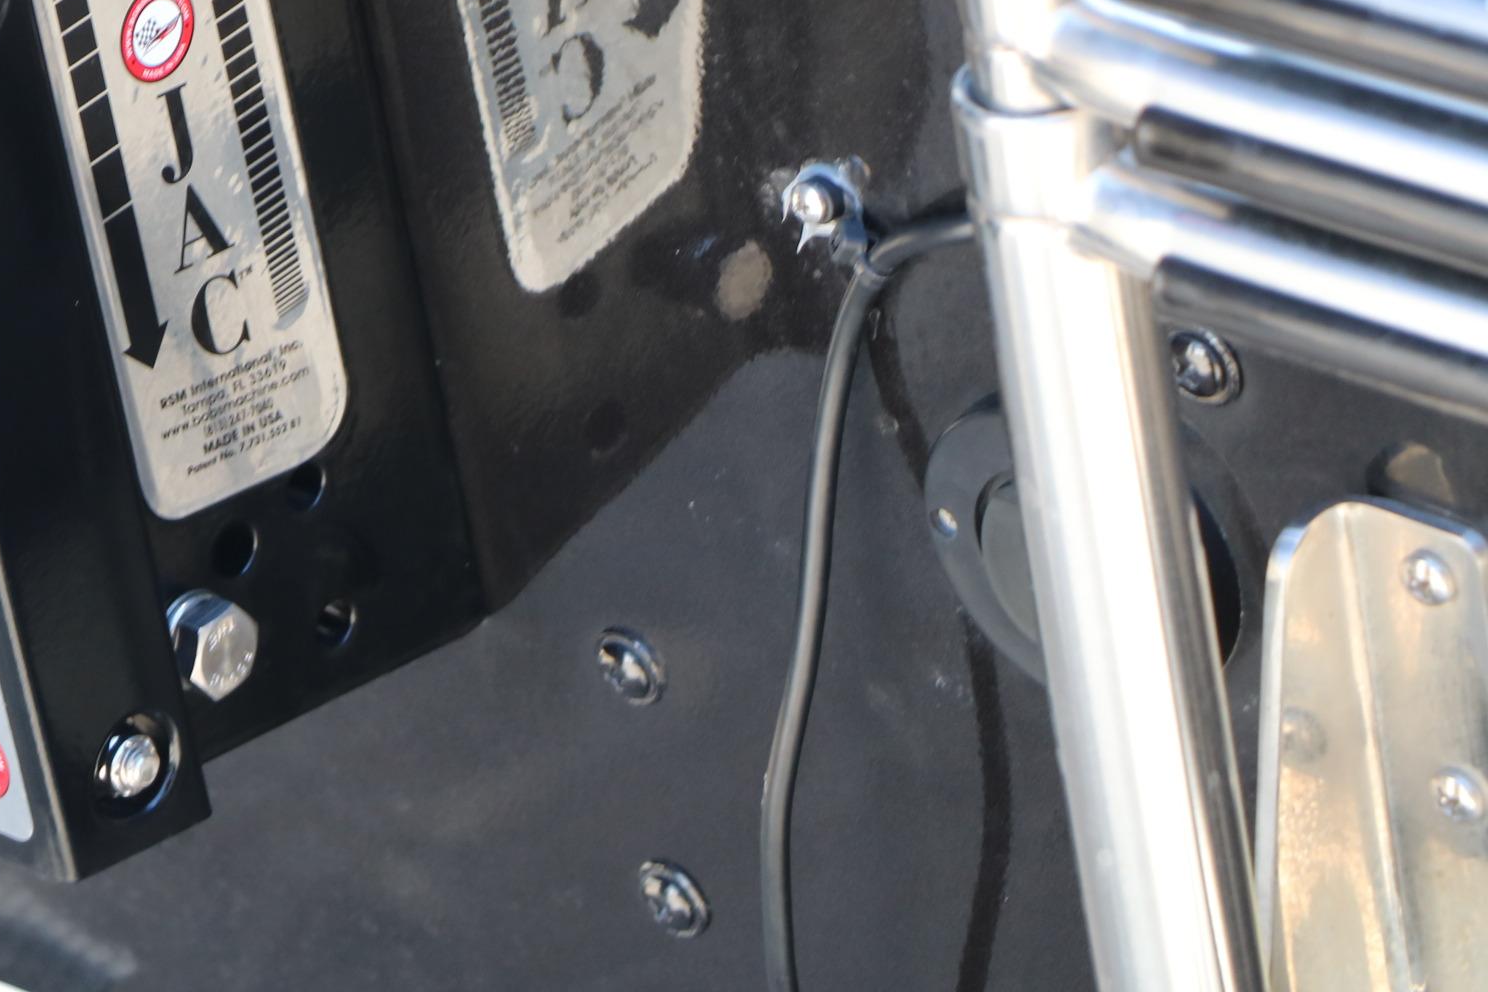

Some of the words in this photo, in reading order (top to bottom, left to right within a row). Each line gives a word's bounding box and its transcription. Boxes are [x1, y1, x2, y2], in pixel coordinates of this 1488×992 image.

[157, 83, 251, 356] JAC
[160, 390, 188, 410] RSM
[279, 339, 303, 358] Inc.
[161, 365, 310, 440] www.bobsmachine.com
[232, 379, 246, 395] FL
[249, 359, 287, 384] 33619
[203, 430, 240, 456] MADE
[242, 421, 257, 436] IN
[259, 409, 284, 429] USA
[187, 455, 218, 477] Patent
